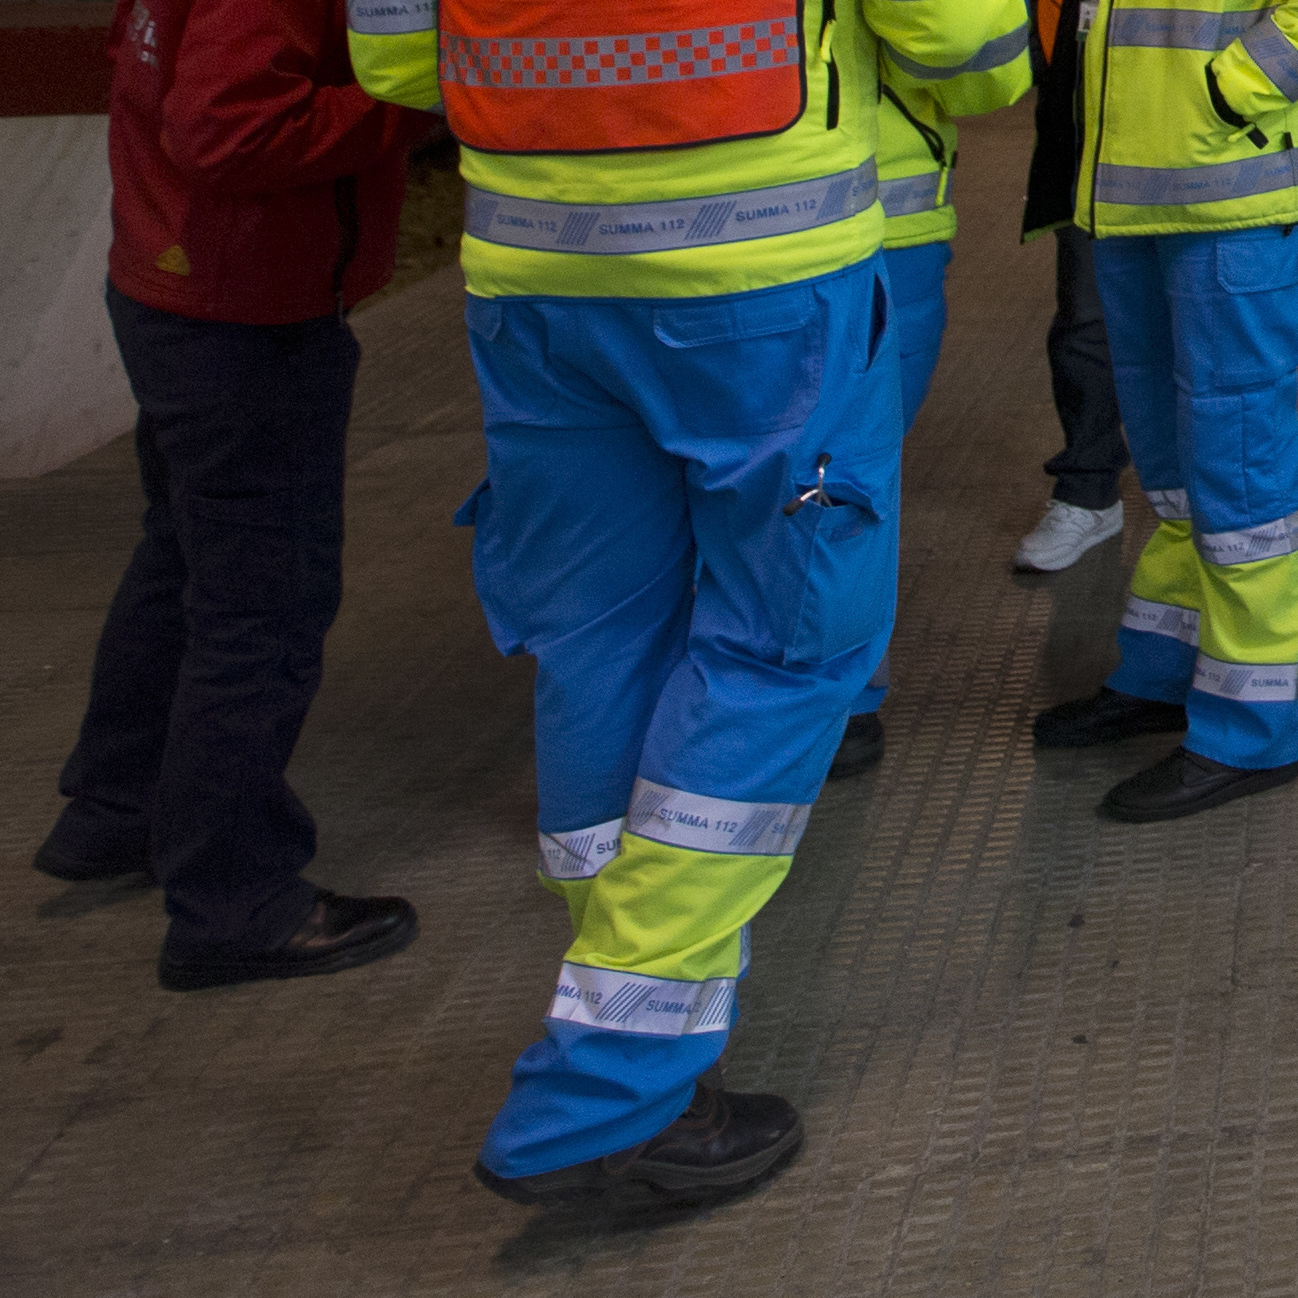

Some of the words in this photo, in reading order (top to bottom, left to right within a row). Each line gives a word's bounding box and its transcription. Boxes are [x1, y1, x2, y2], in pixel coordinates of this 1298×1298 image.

[356, 5, 410, 18] SUMMA
[735, 202, 789, 222] SUMMA
[795, 199, 817, 211] 112
[599, 222, 654, 236] SUMMA
[661, 218, 686, 230] 112
[1251, 678, 1289, 688] SUMMA
[659, 808, 709, 829] SUMMA
[714, 819, 739, 833] 112
[584, 990, 603, 1005] 112
[646, 999, 691, 1015] SUMMA
